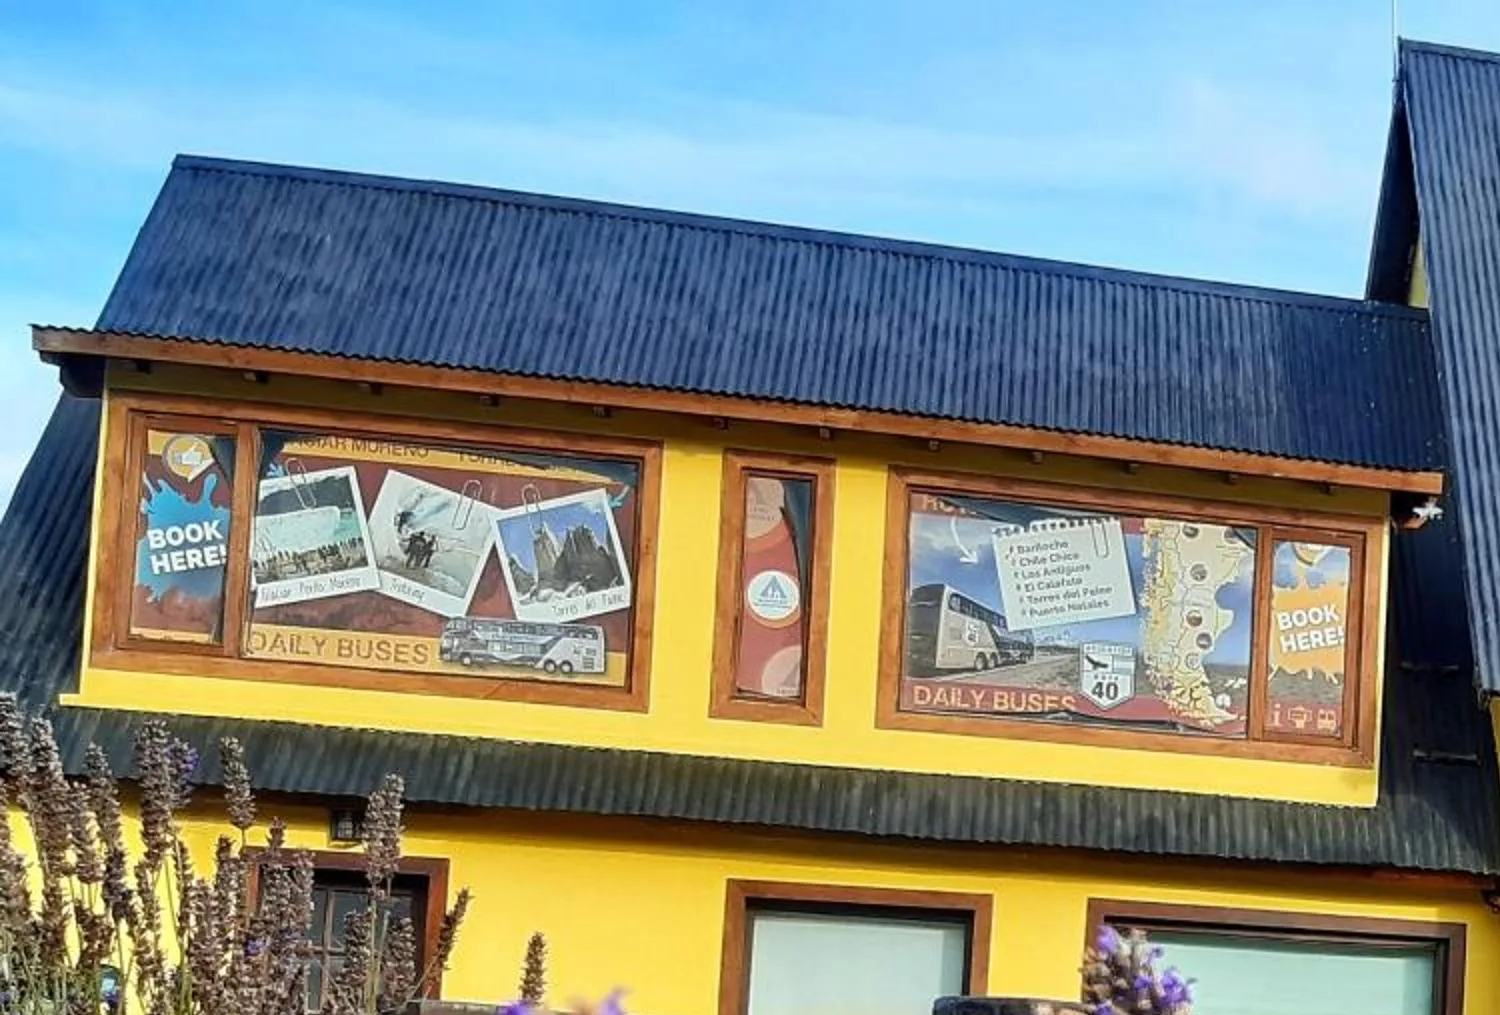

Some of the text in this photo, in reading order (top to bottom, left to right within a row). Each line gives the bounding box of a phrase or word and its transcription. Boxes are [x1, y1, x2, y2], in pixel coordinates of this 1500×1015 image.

[147, 519, 222, 549] BOOK
[150, 545, 227, 574] HERE!
[1277, 604, 1340, 631] BOOK
[250, 631, 430, 665] DAILY BUSES
[913, 685, 1076, 712] DAILY BUSES
[1091, 681, 1118, 701] 40
